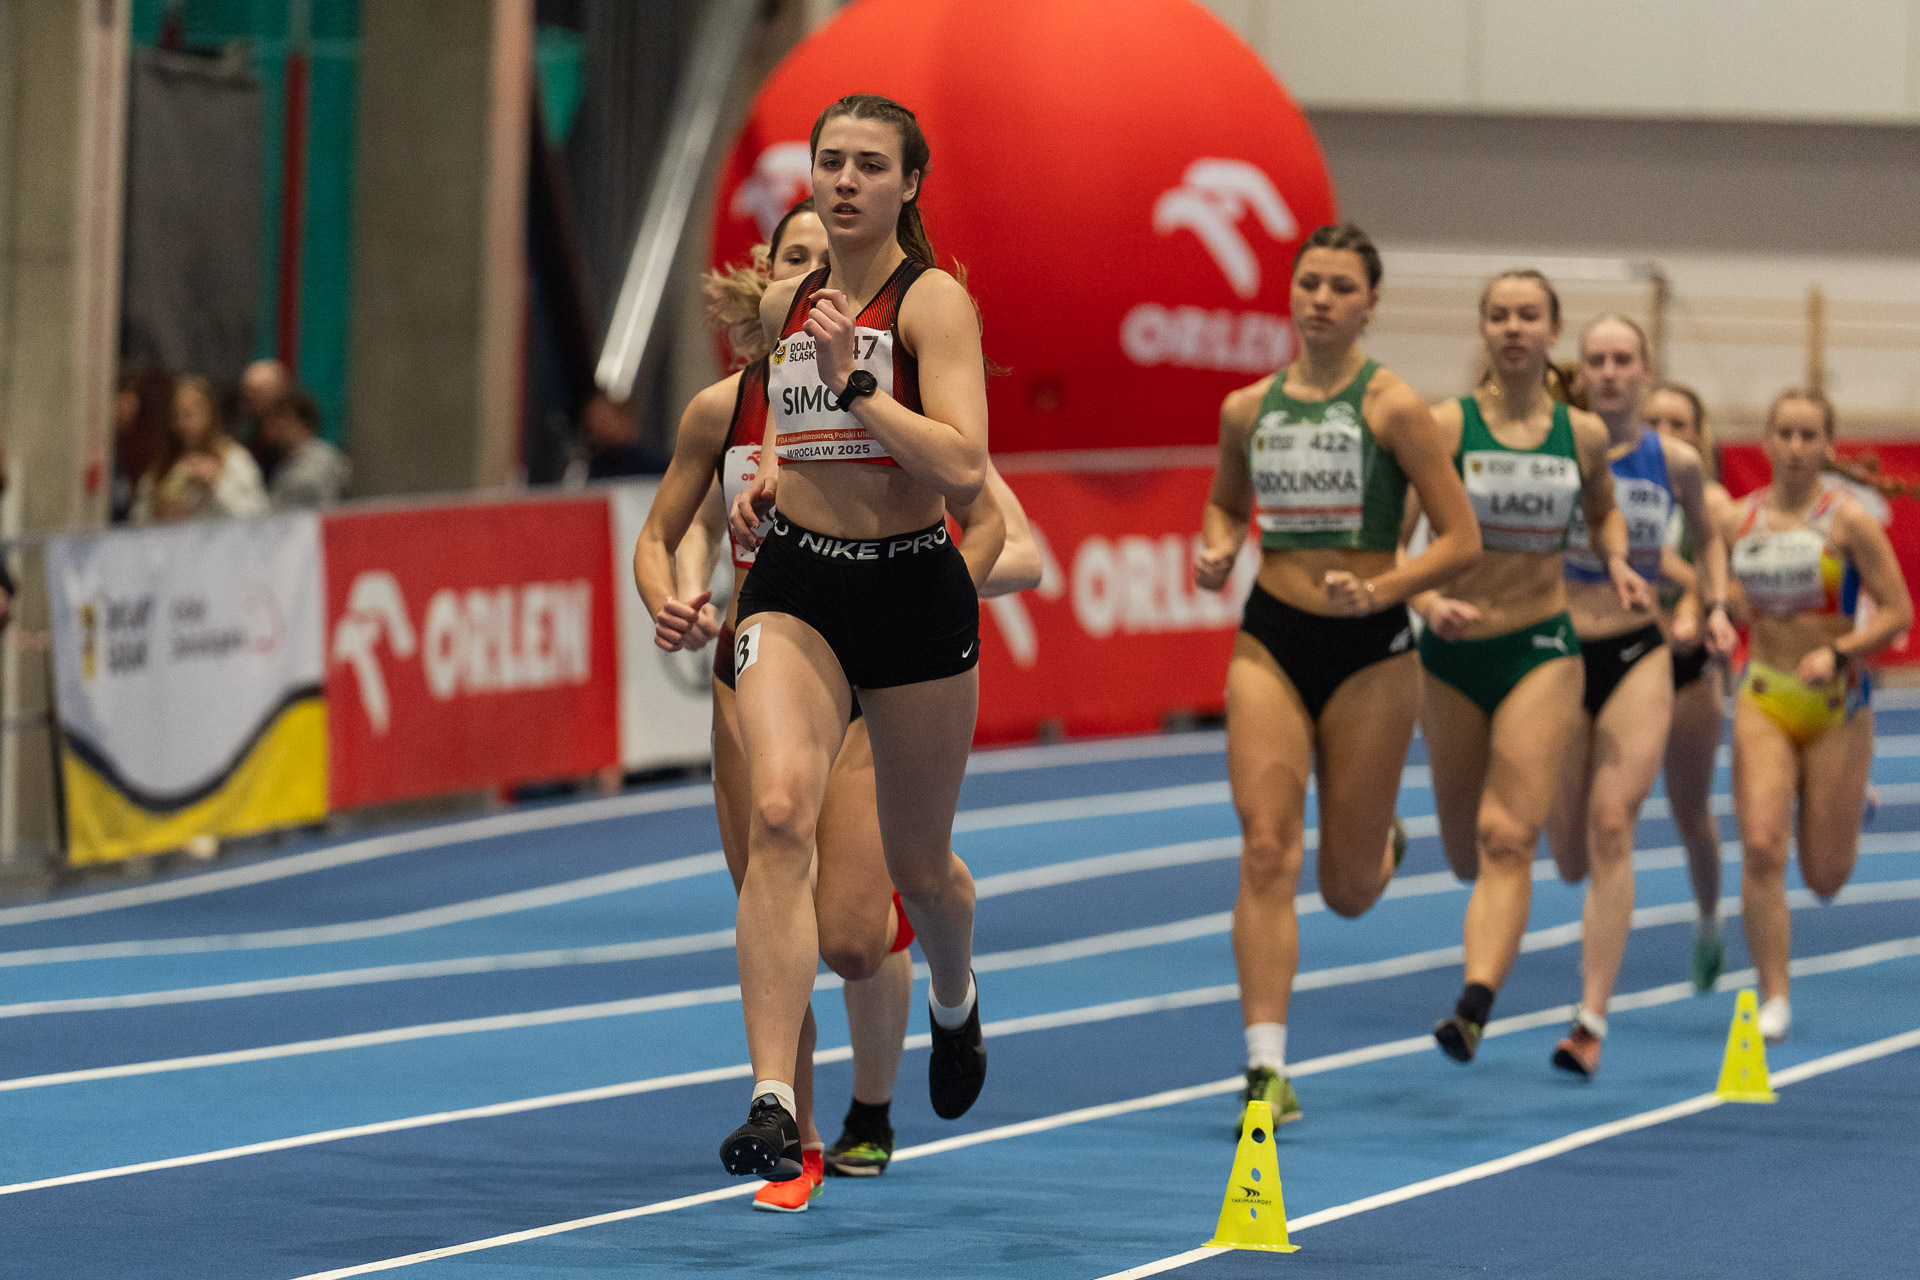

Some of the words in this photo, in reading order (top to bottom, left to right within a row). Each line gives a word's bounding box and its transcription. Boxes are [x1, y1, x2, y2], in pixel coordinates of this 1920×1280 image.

[786, 445, 835, 459] WROCŁAW
[837, 444, 871, 455] 2025
[798, 532, 881, 561] NIKE
[888, 526, 948, 559] PRO
[423, 577, 593, 701] ORLEN
[736, 633, 750, 676] 3
